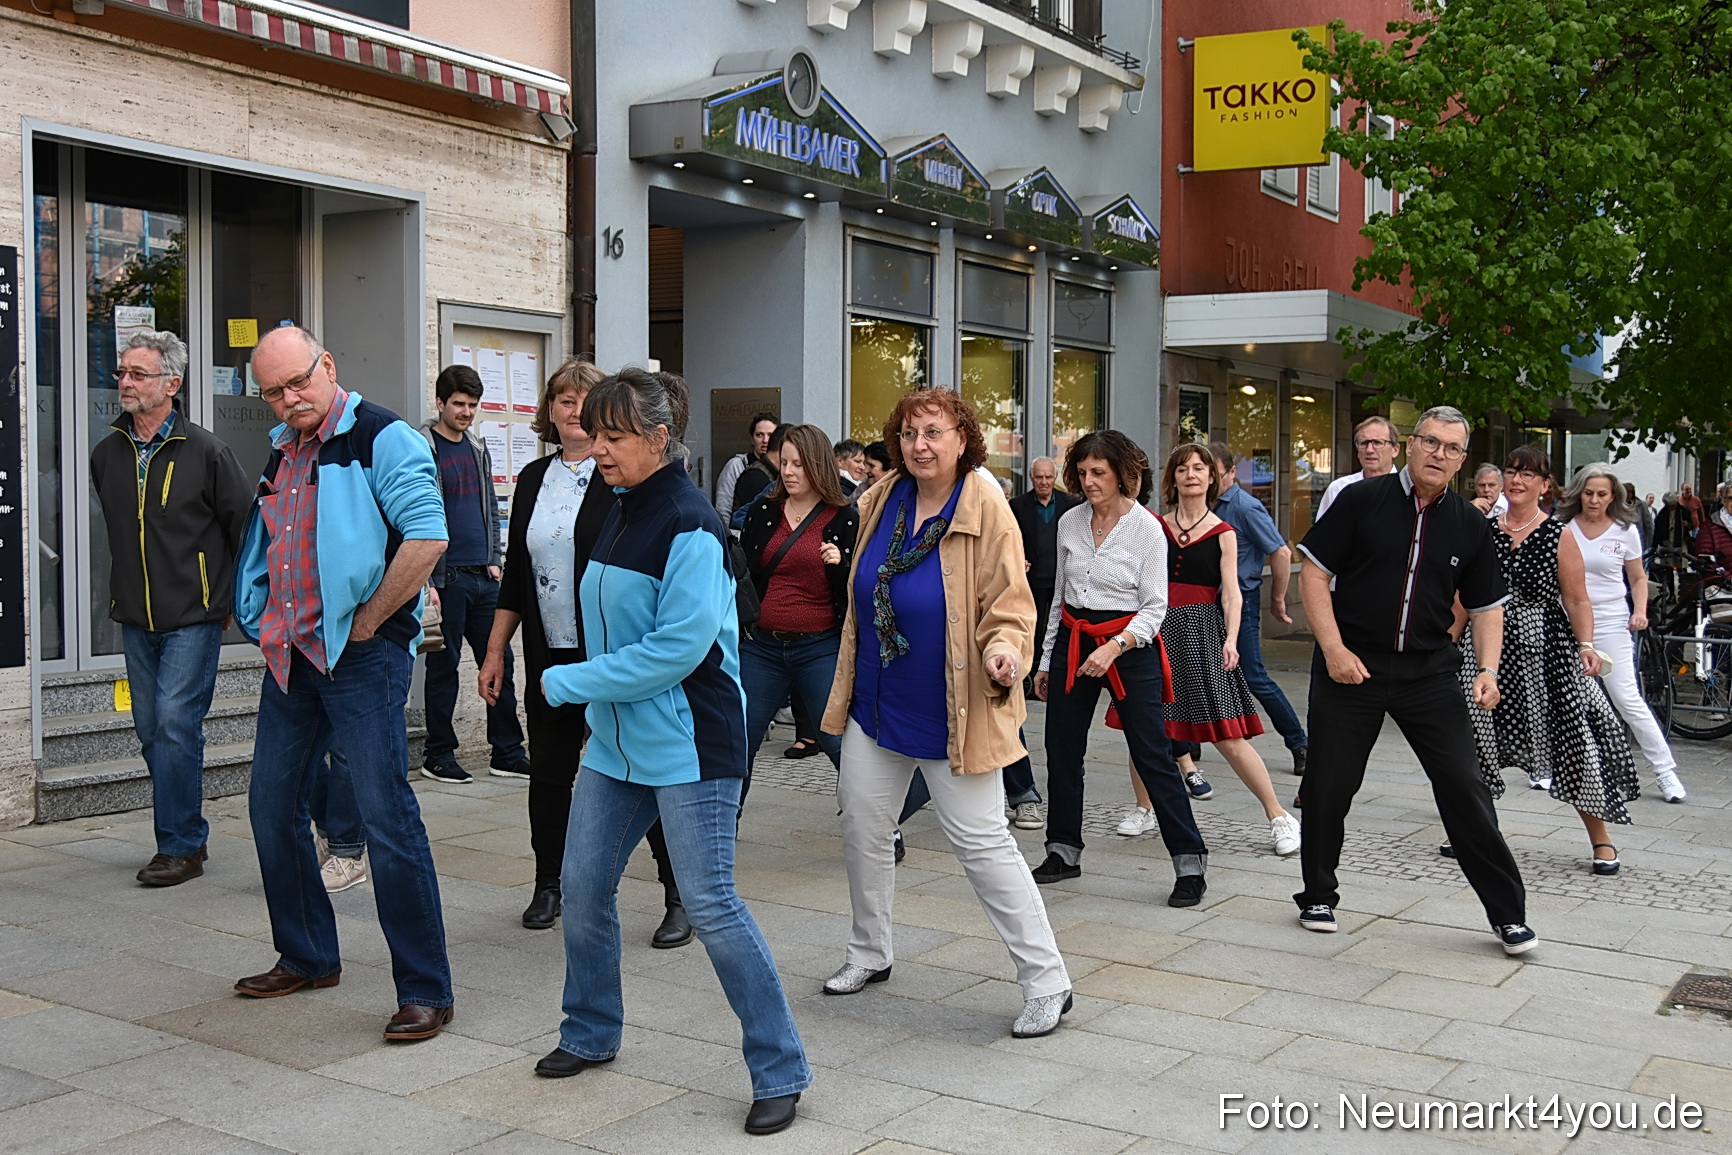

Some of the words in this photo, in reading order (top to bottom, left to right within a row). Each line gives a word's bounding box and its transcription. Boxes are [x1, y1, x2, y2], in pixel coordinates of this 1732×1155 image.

[1220, 108, 1298, 123] FASHION
[734, 106, 861, 178] MÜHLBAUER
[924, 159, 963, 191] UHREN
[1031, 191, 1058, 217] OPTIK
[602, 225, 624, 260] 16
[1107, 213, 1147, 243] SCHMUCK
